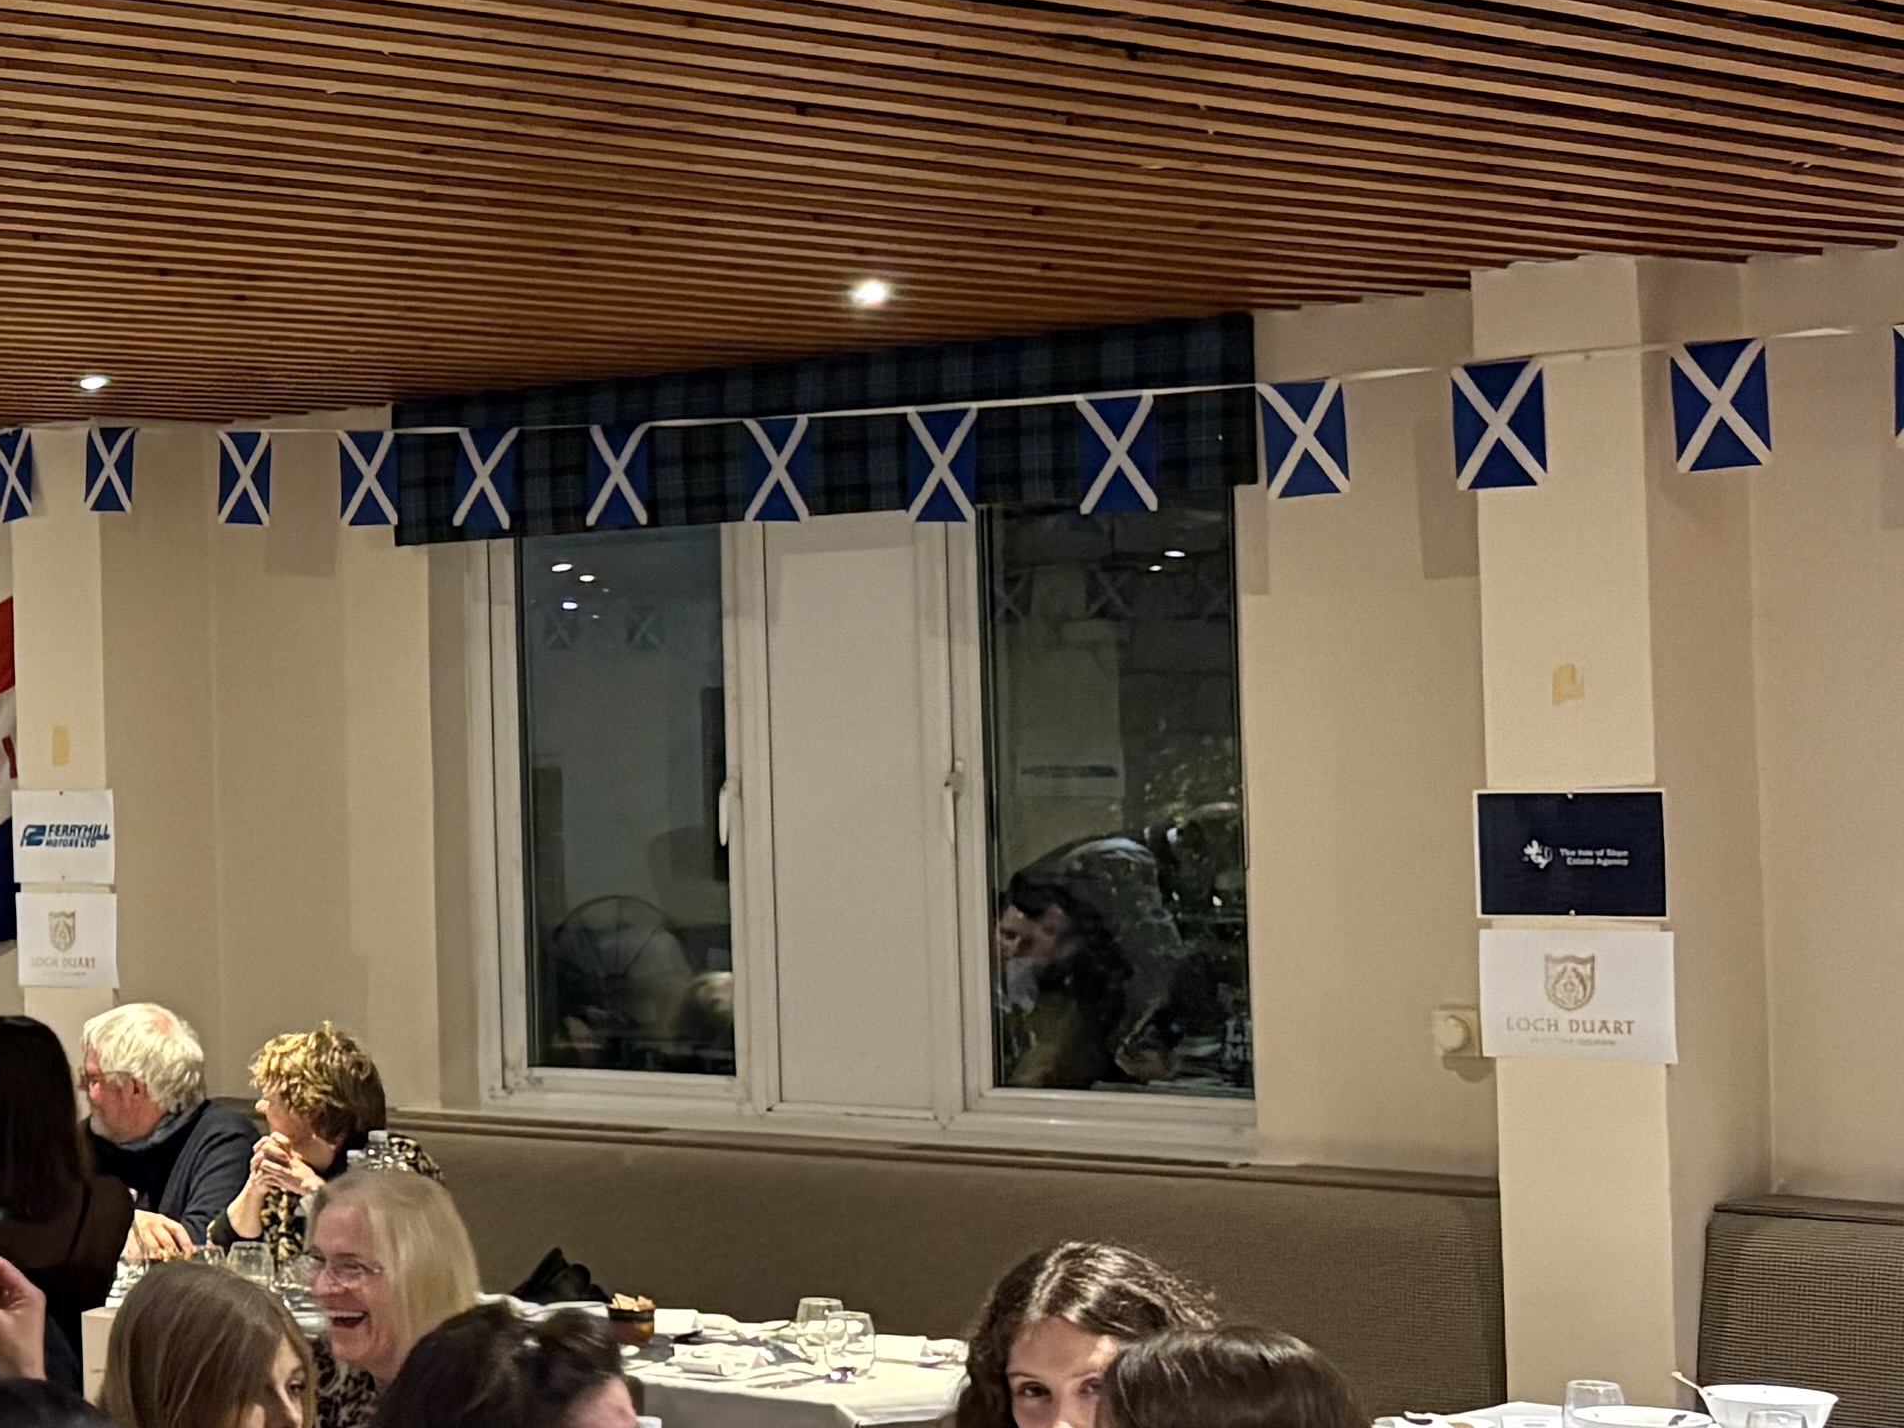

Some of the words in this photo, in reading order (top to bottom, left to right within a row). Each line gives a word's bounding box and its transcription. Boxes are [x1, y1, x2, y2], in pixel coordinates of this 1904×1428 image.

[48, 824, 111, 840] FERRYMILL
[1506, 1017, 1559, 1033] LOCH
[1569, 1019, 1636, 1035] DUART
